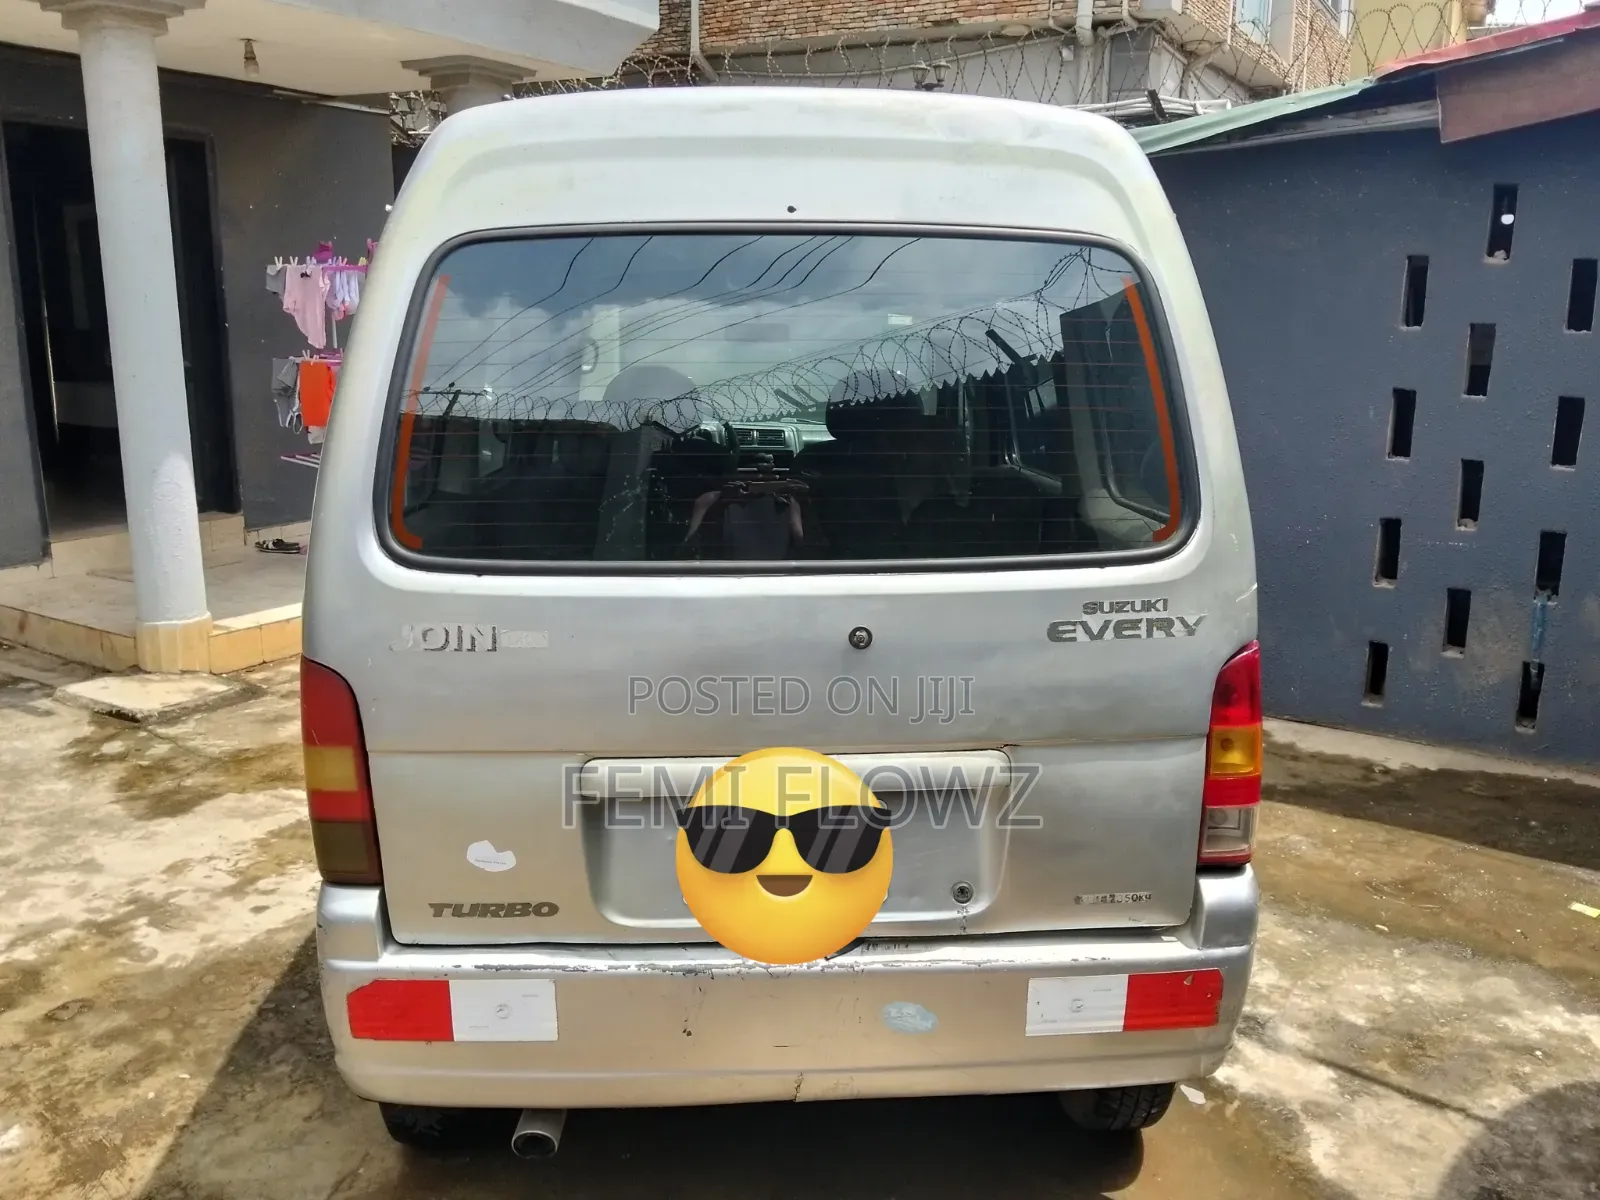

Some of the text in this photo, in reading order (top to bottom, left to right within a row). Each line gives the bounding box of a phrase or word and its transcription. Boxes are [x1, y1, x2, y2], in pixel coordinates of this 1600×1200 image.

[1082, 598, 1169, 615] SUZUKI
[1047, 614, 1209, 642] EVERY
[428, 901, 560, 918] TURBO
